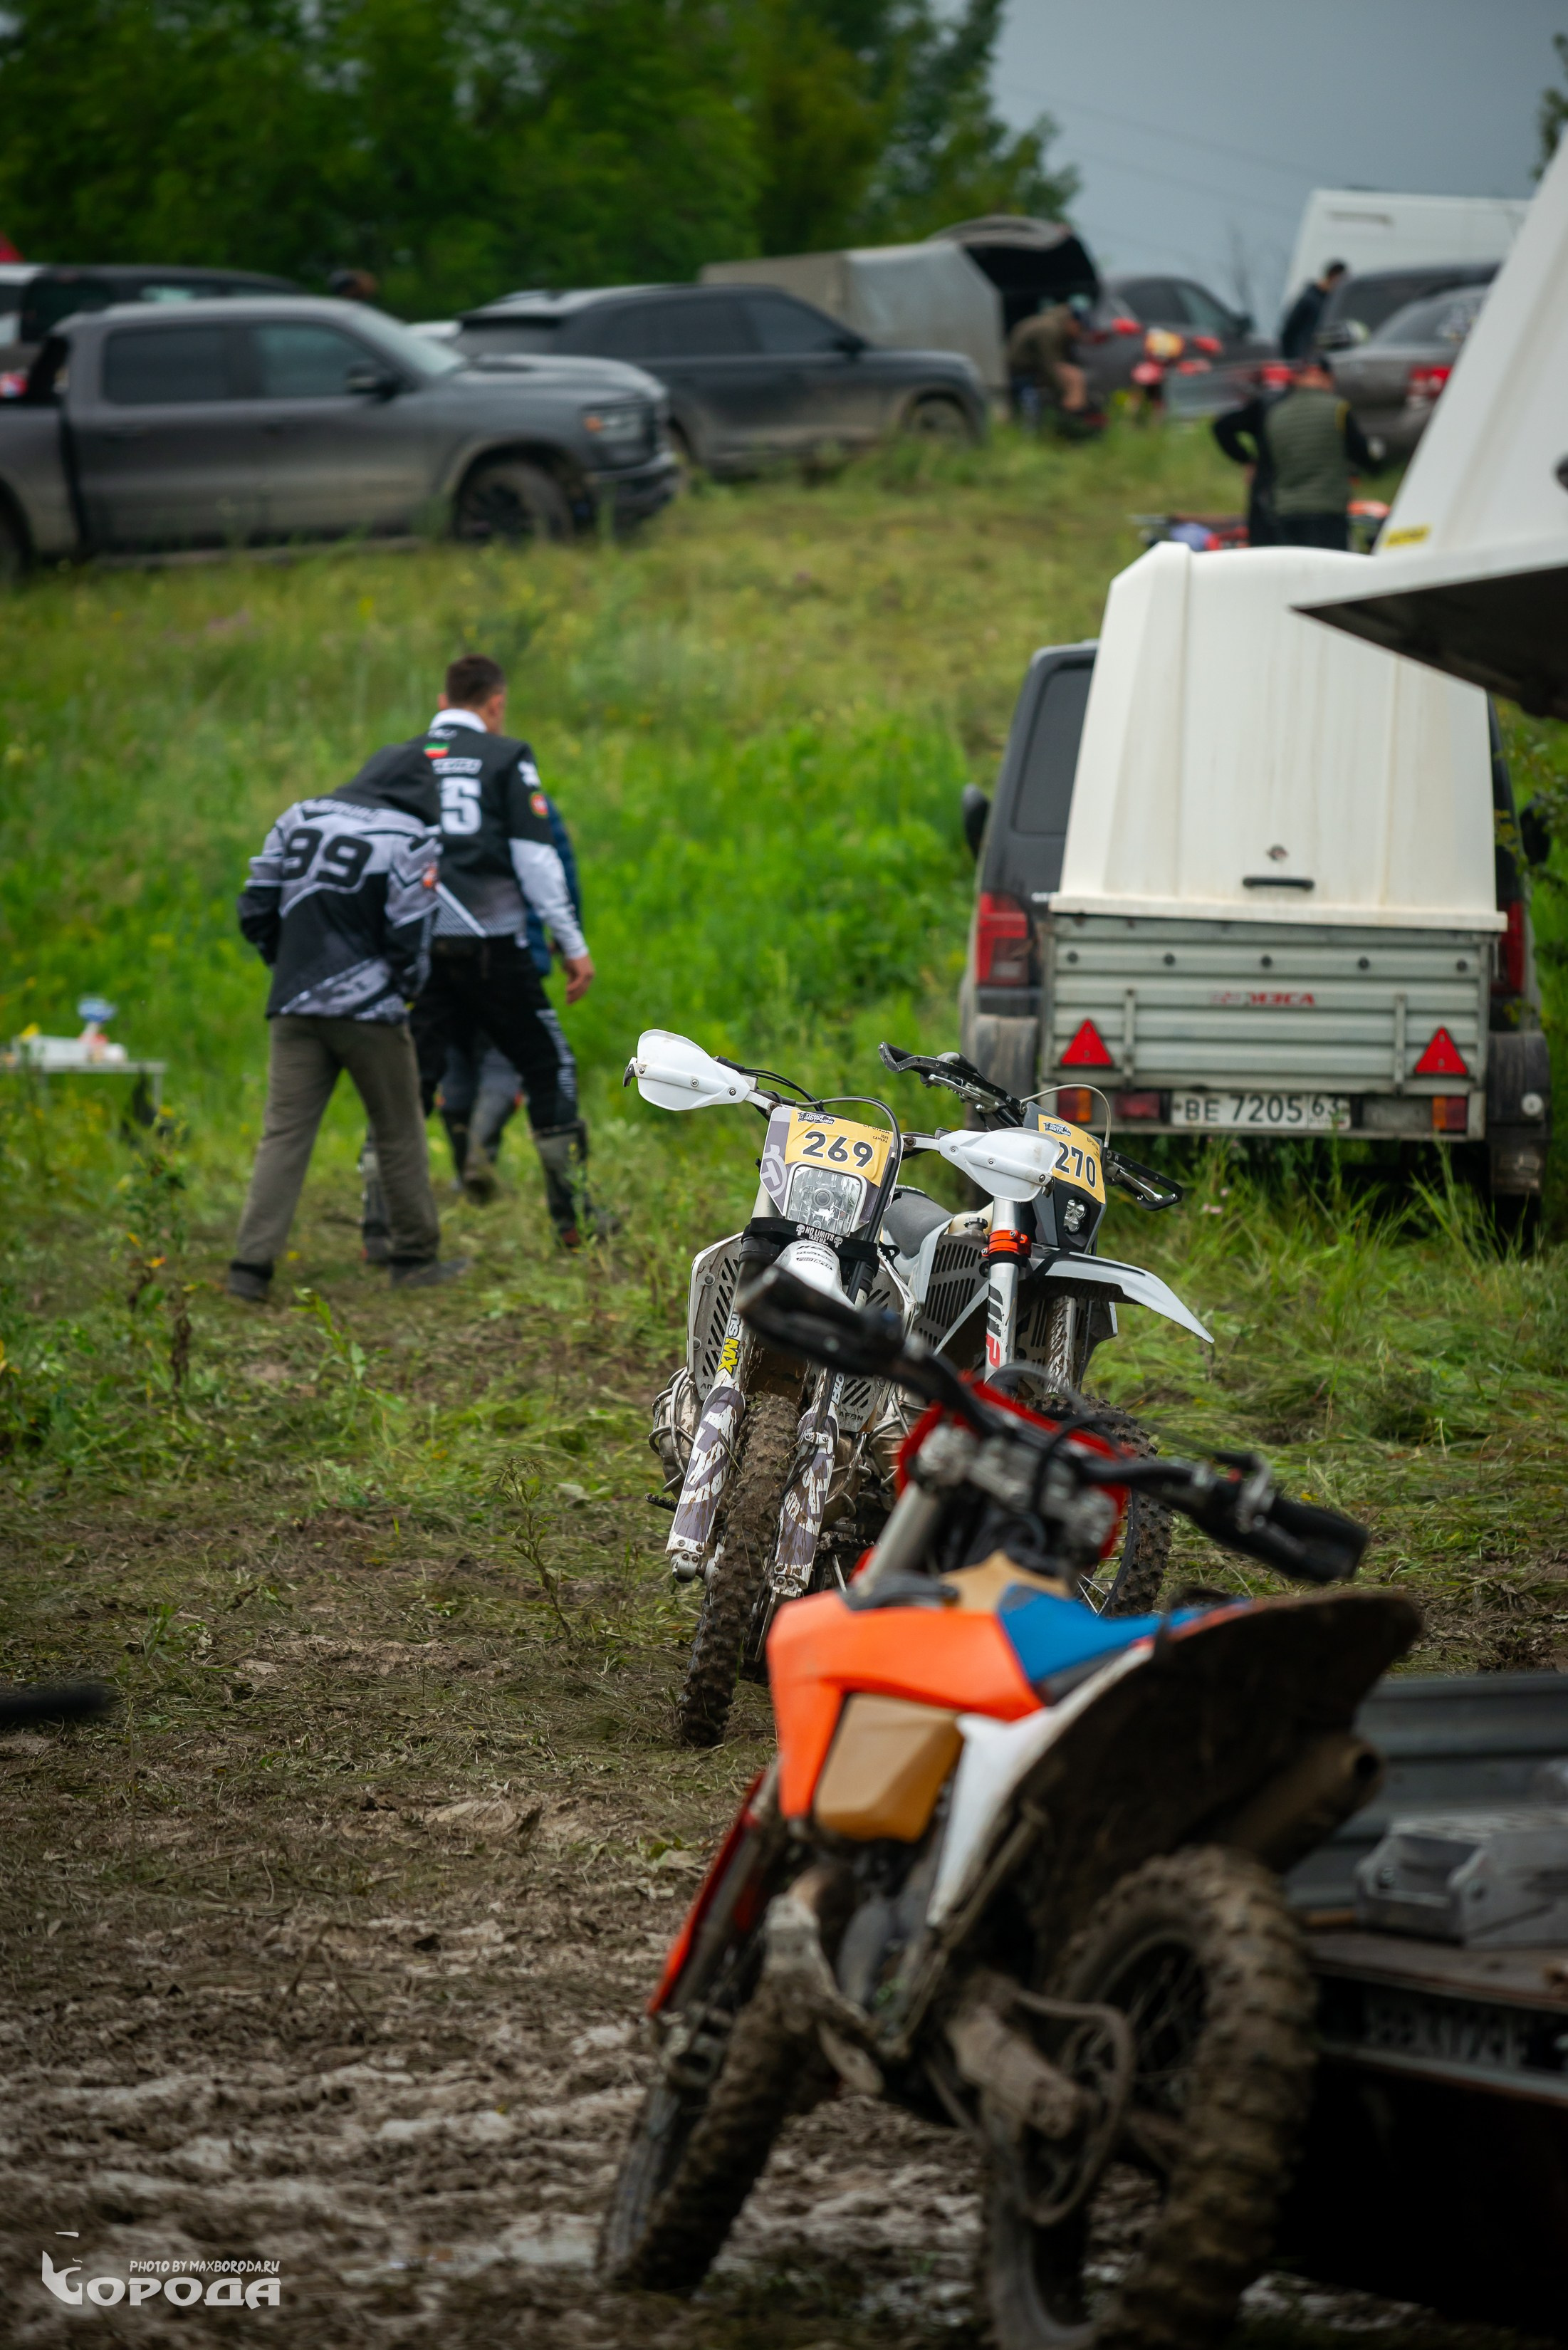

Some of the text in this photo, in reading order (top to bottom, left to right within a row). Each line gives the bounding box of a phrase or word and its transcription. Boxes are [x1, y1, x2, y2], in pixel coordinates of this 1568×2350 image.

[439, 777, 482, 835] 5
[283, 827, 373, 888] 99
[1228, 1095, 1302, 1123] 7205
[802, 1131, 874, 1168] 269
[1055, 1142, 1096, 1189] 270
[805, 1226, 835, 1242] NO LIMITS
